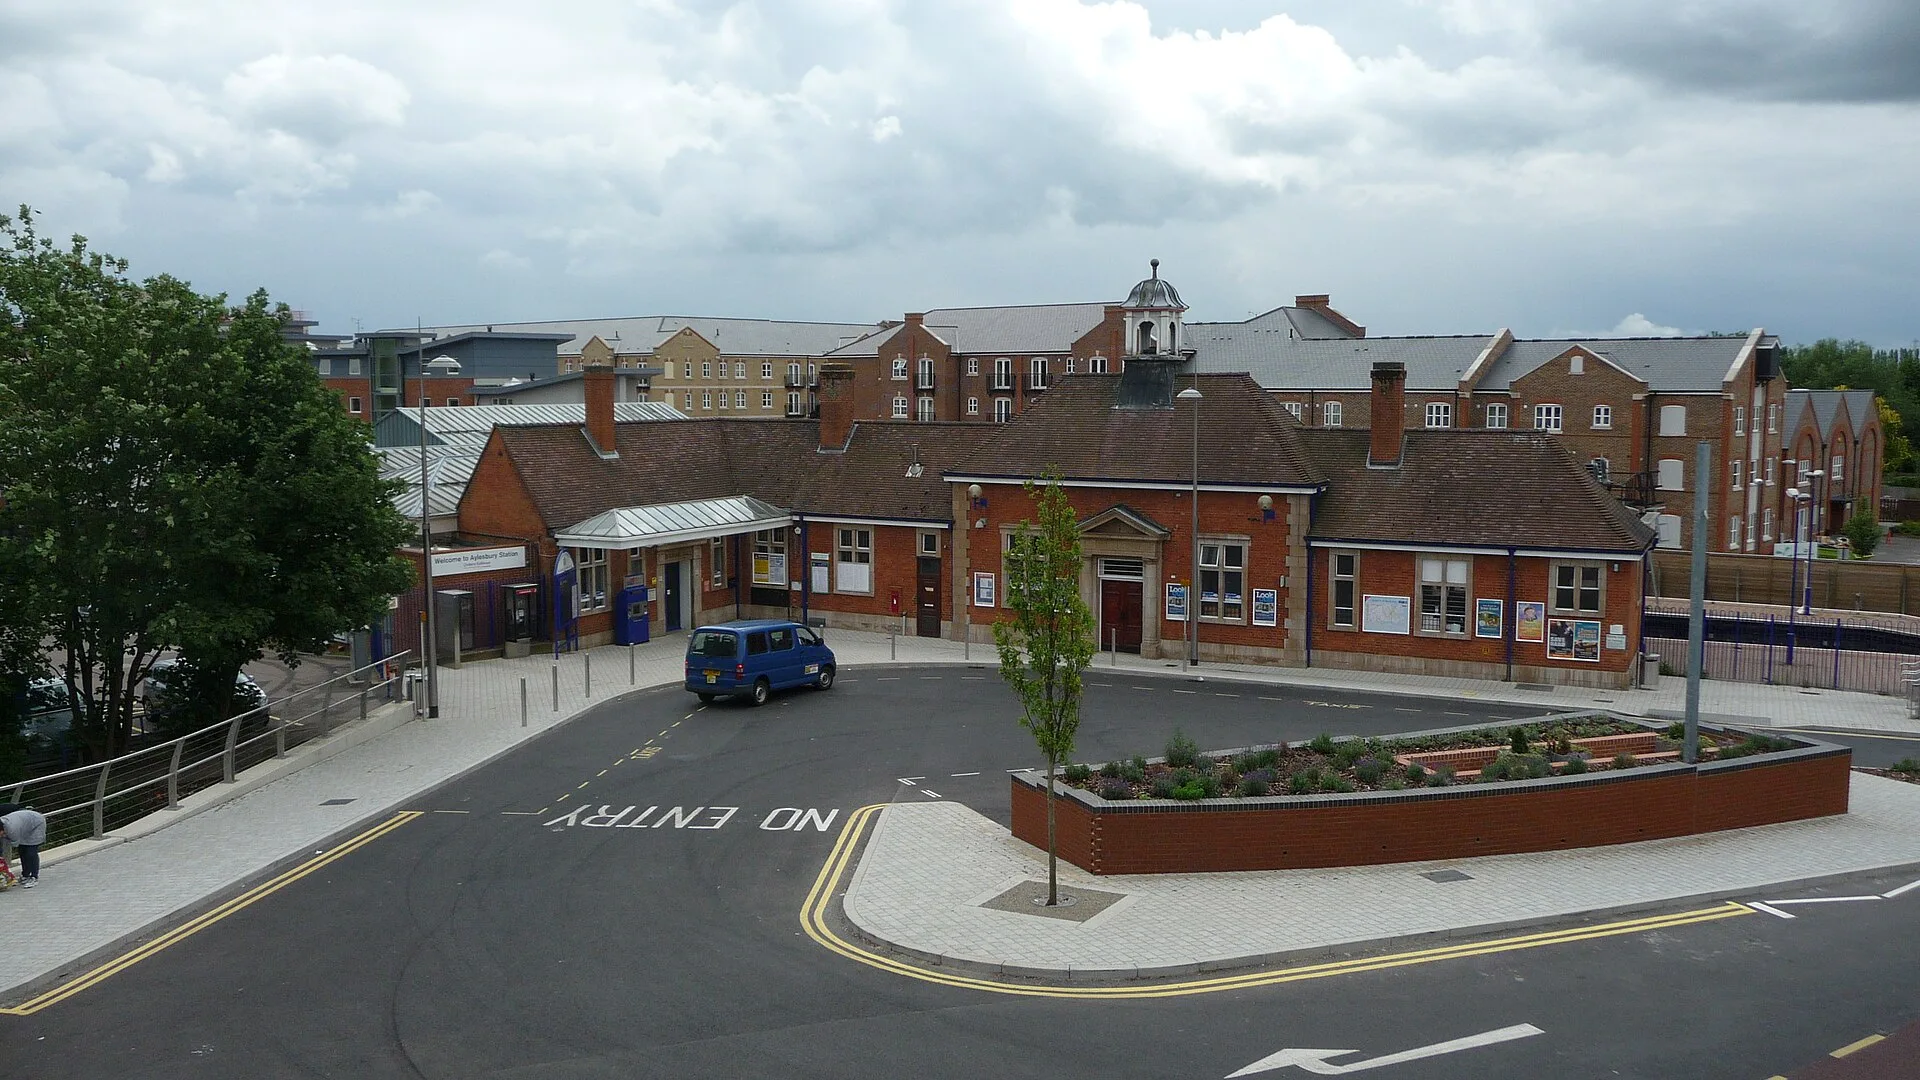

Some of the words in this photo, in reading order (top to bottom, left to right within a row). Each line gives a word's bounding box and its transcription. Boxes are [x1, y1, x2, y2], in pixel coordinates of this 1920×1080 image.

[470, 553, 497, 561] Aylesbury
[1256, 591, 1274, 599] Look
[543, 804, 739, 829] ENTRY
[759, 807, 839, 832] NO
